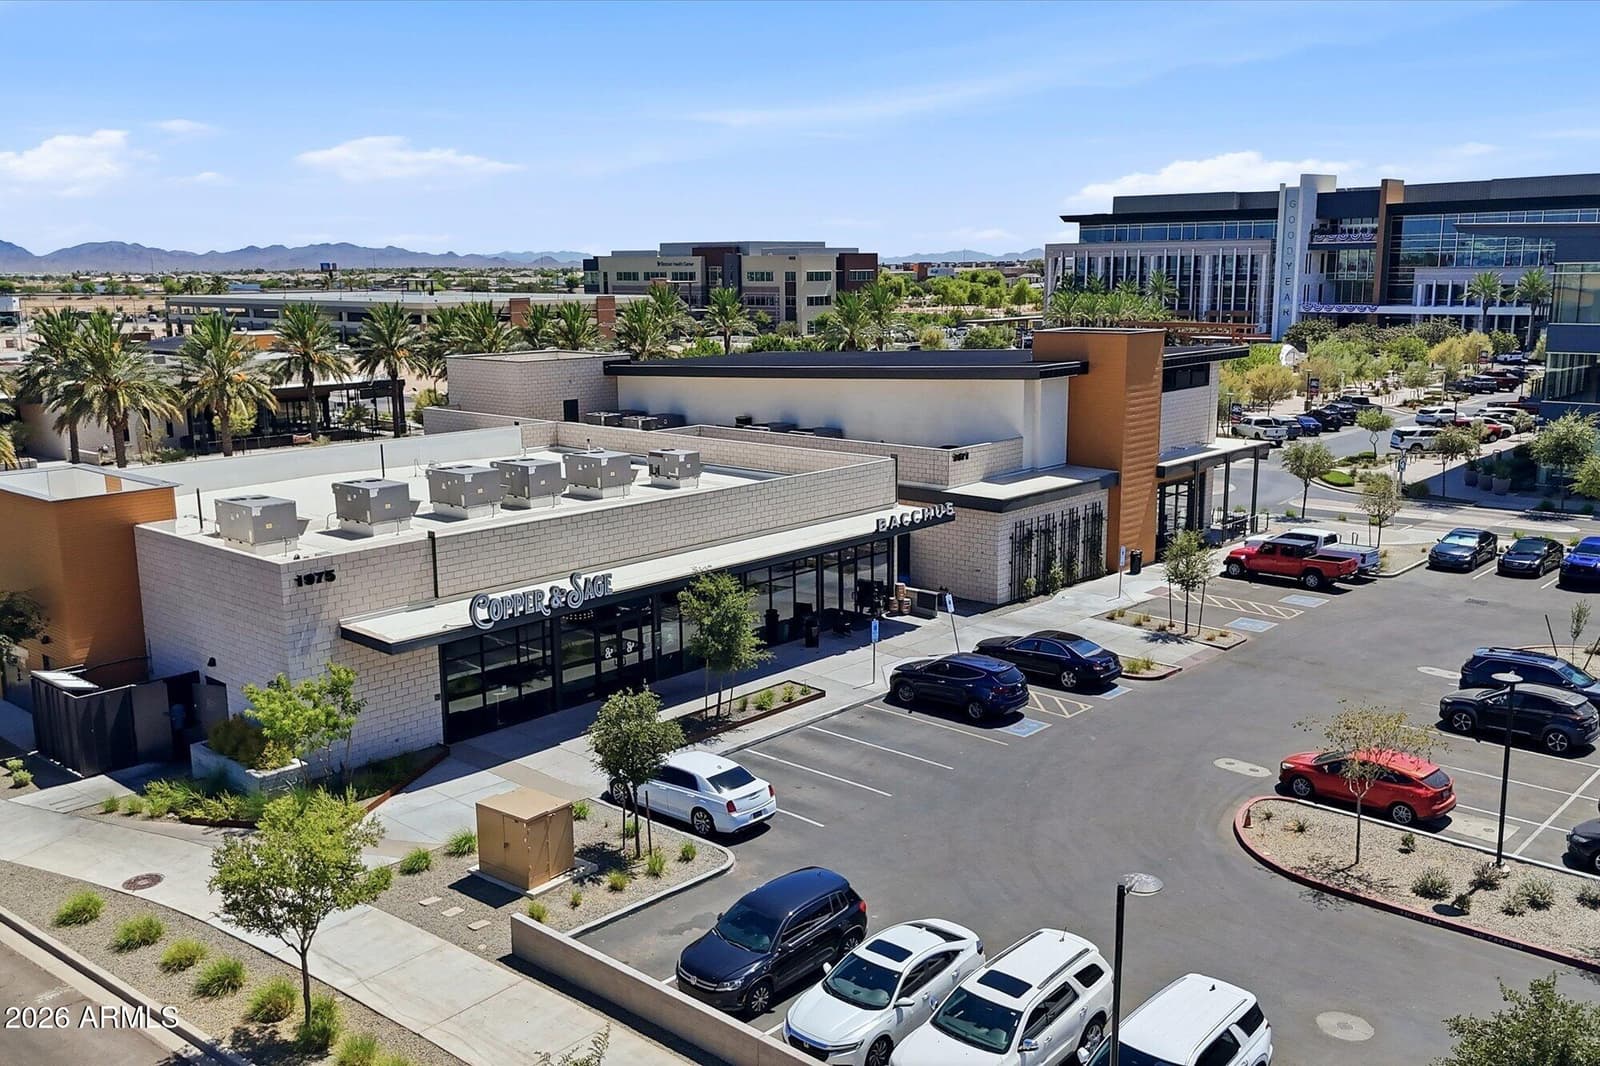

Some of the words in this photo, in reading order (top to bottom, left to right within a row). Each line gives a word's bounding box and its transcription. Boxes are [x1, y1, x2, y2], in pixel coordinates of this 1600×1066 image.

[1283, 199, 1297, 316] GOODYEAR
[876, 502, 955, 532] BACCHUS
[294, 569, 336, 587] 1975
[469, 589, 550, 630] COPPER
[550, 585, 566, 608] &
[567, 572, 613, 609] SAGE
